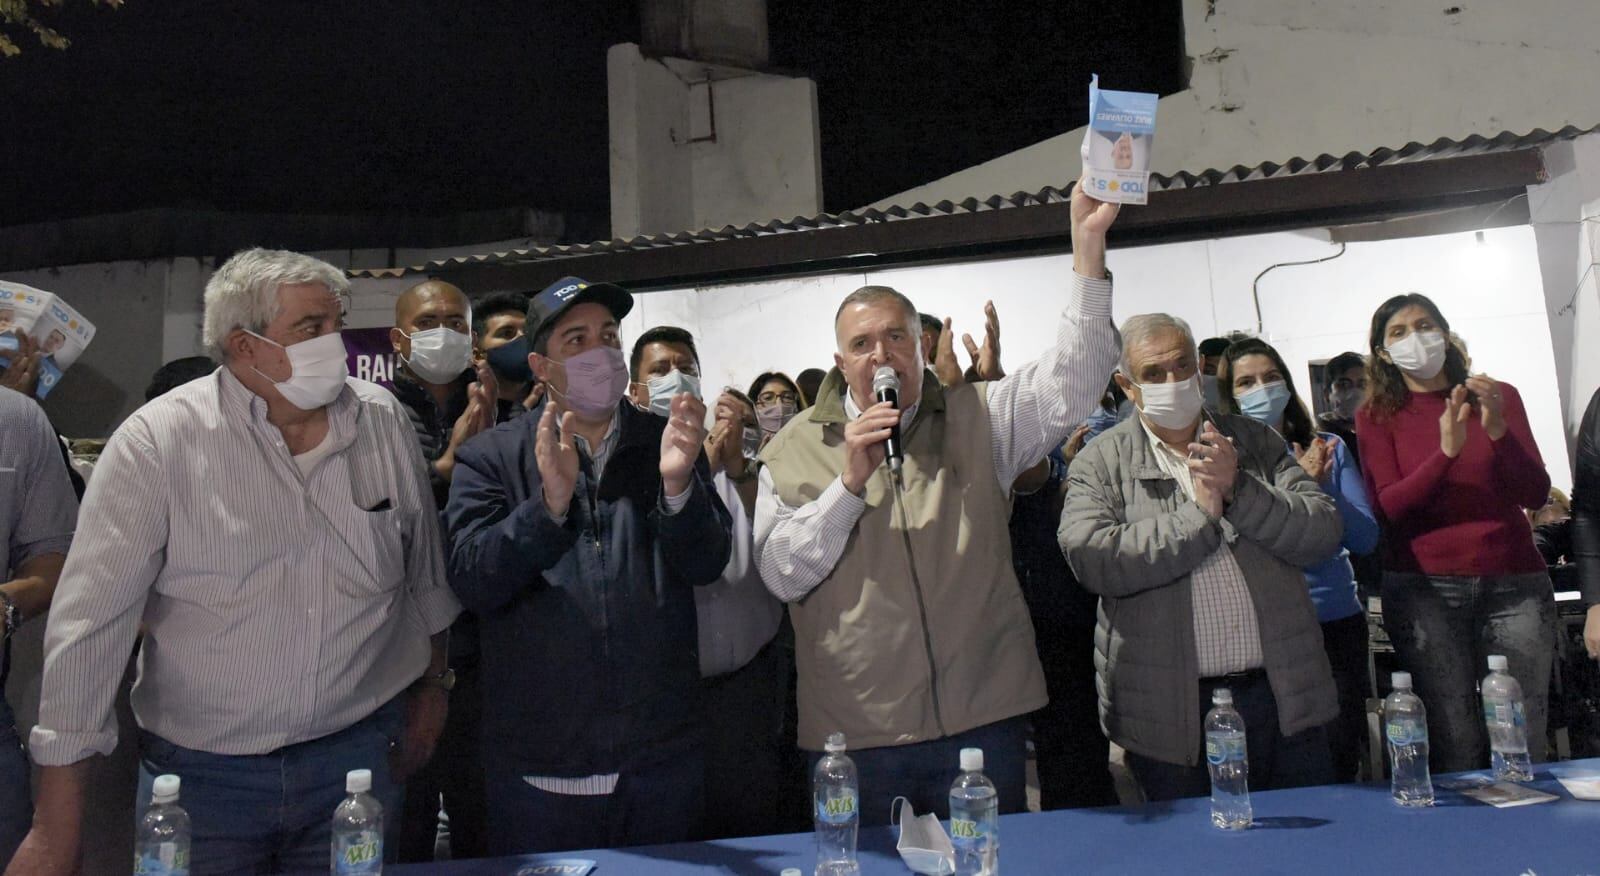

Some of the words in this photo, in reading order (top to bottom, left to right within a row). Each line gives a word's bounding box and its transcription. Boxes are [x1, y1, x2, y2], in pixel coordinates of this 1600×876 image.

[1095, 112, 1133, 122] OLIVARES
[824, 795, 855, 816] AXIS
[344, 842, 378, 865] AXIS
